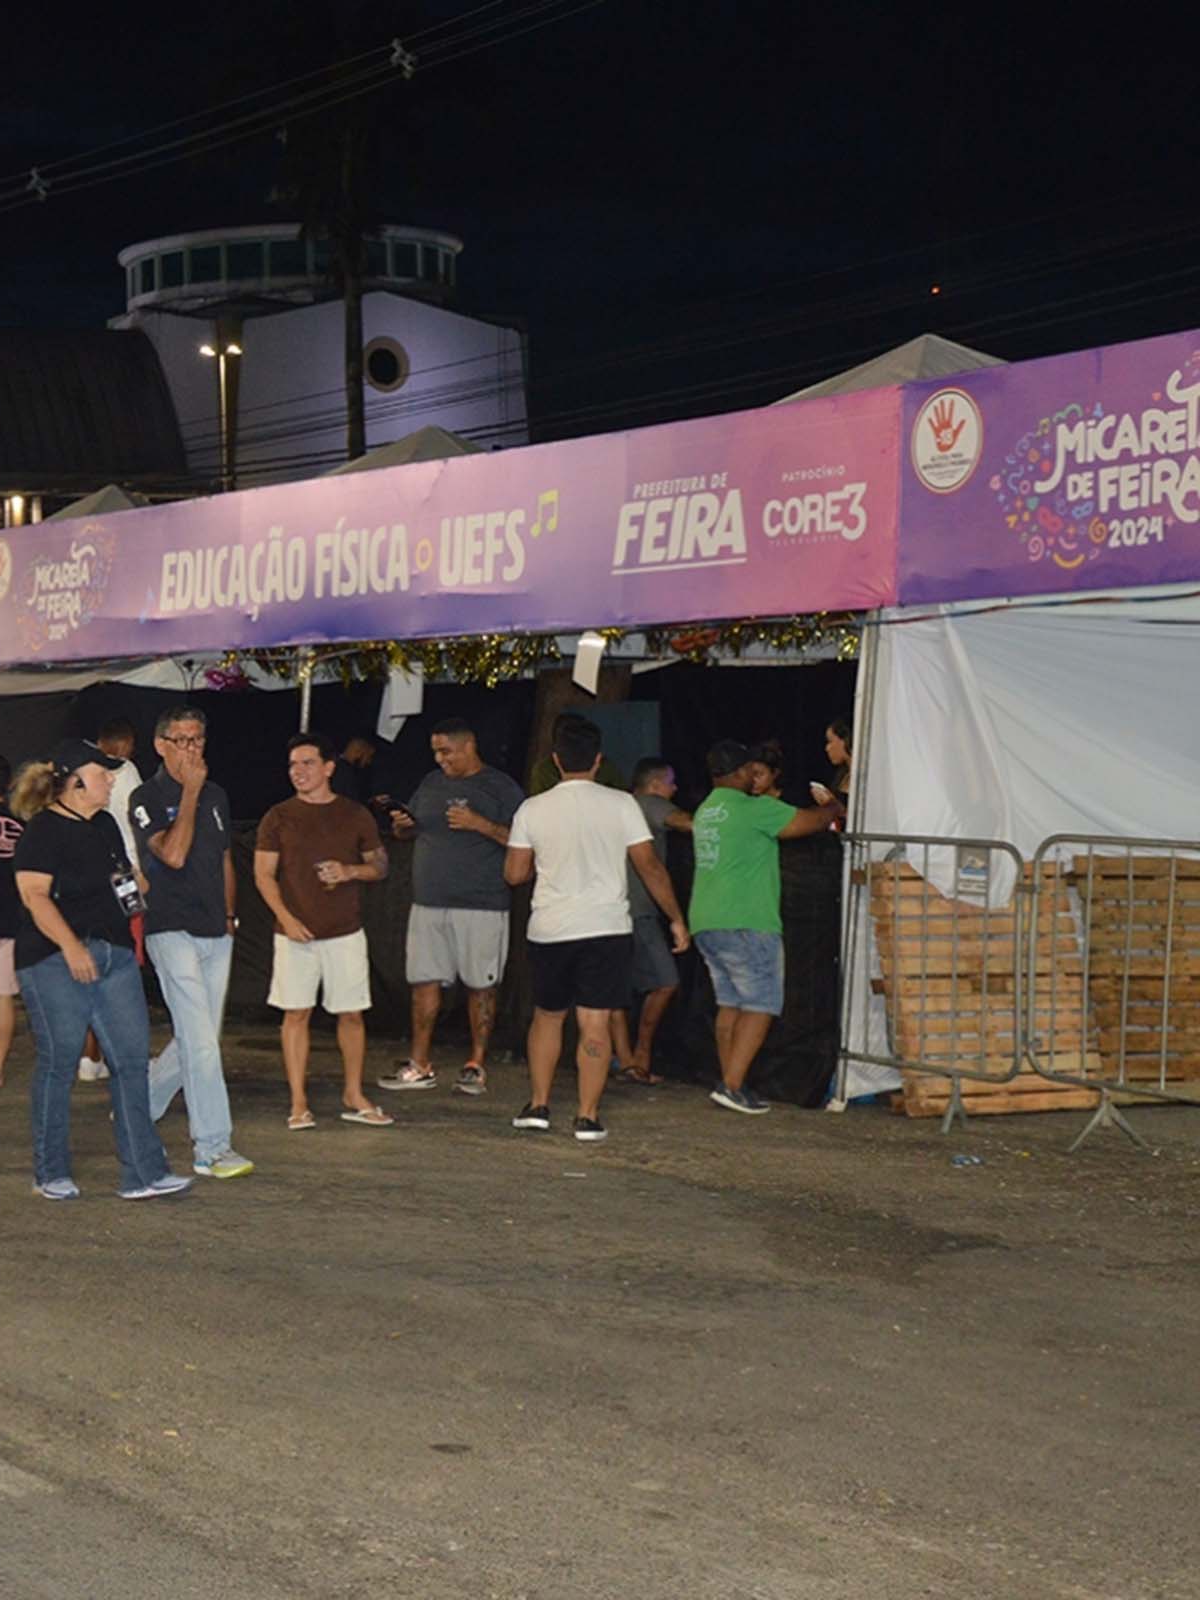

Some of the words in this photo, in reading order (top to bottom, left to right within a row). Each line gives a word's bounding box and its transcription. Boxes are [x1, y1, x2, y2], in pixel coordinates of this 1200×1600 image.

[1034, 370, 1200, 493] MICARET
[633, 474, 705, 499] PREFEITURA
[711, 472, 728, 489] DE
[781, 464, 846, 482] PATROCÍNIO
[1067, 472, 1094, 501] DE
[612, 488, 747, 566] FEIRA
[762, 482, 867, 541] CORE3
[1108, 515, 1164, 548] 2024
[159, 525, 307, 622] EDUCAÇÃO
[314, 516, 410, 599] FÍSICA
[438, 508, 526, 587] UEFS
